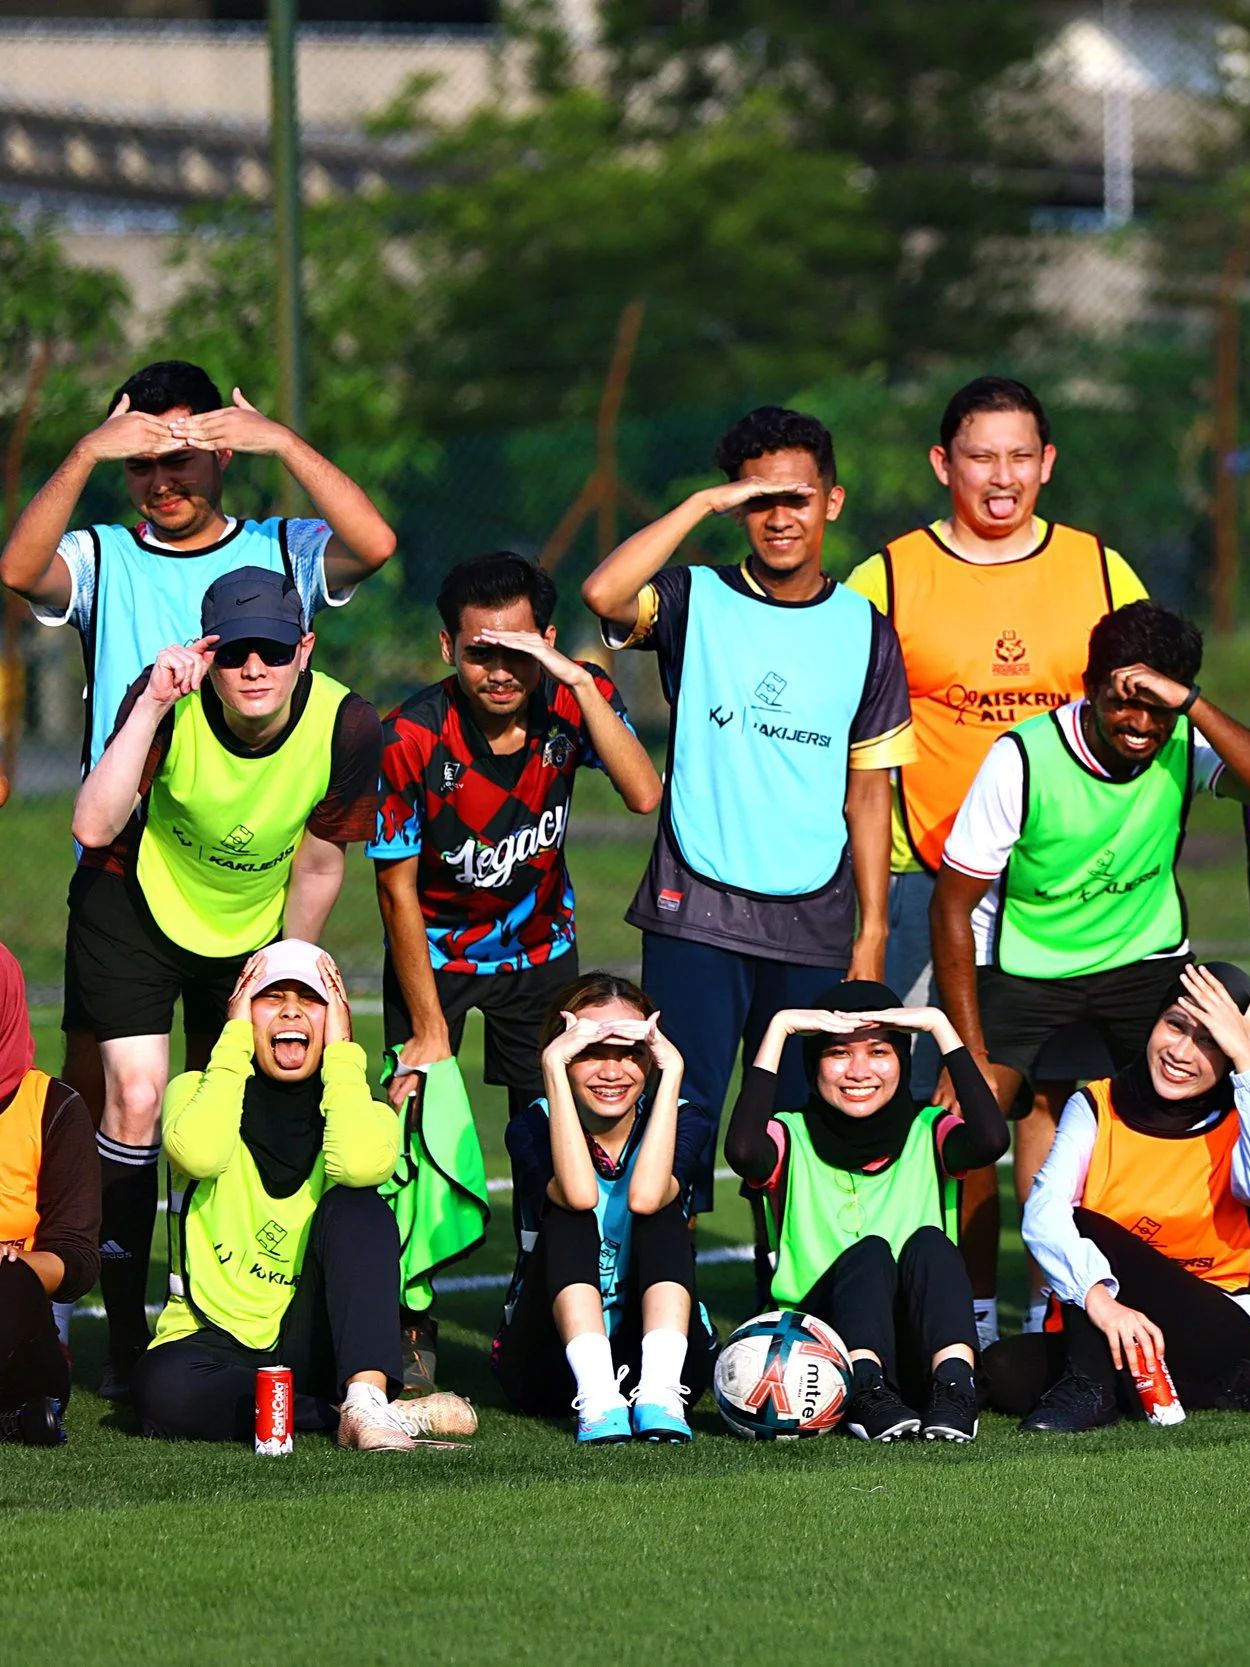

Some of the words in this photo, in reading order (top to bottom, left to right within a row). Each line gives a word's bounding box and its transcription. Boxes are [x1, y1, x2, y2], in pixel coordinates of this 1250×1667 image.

[980, 709, 1015, 722] ALI
[753, 722, 831, 748] AKIJERSI
[802, 1363, 821, 1418] mitre
